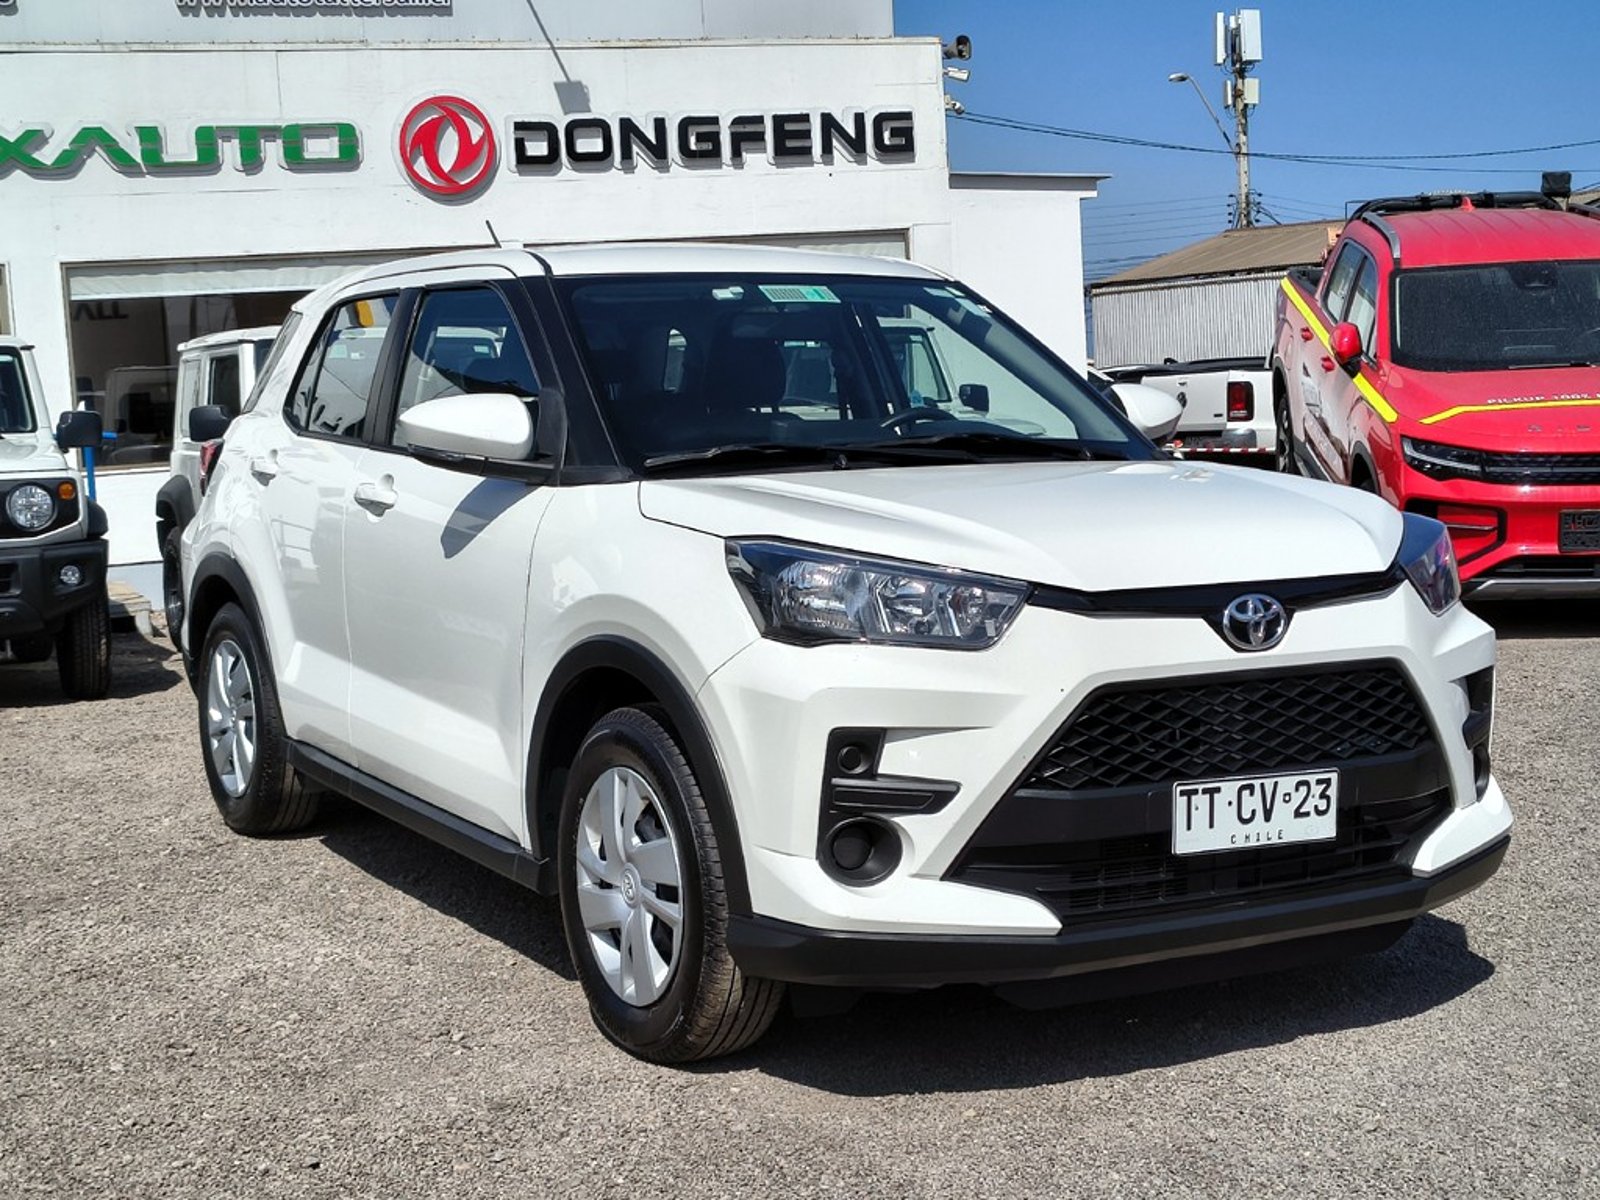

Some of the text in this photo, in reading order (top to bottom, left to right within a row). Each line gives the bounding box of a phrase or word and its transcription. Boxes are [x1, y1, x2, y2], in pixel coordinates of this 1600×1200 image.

[513, 111, 913, 165] DONGFENG
[1487, 396, 1544, 404] PICKUP
[1231, 829, 1284, 845] CHILE
